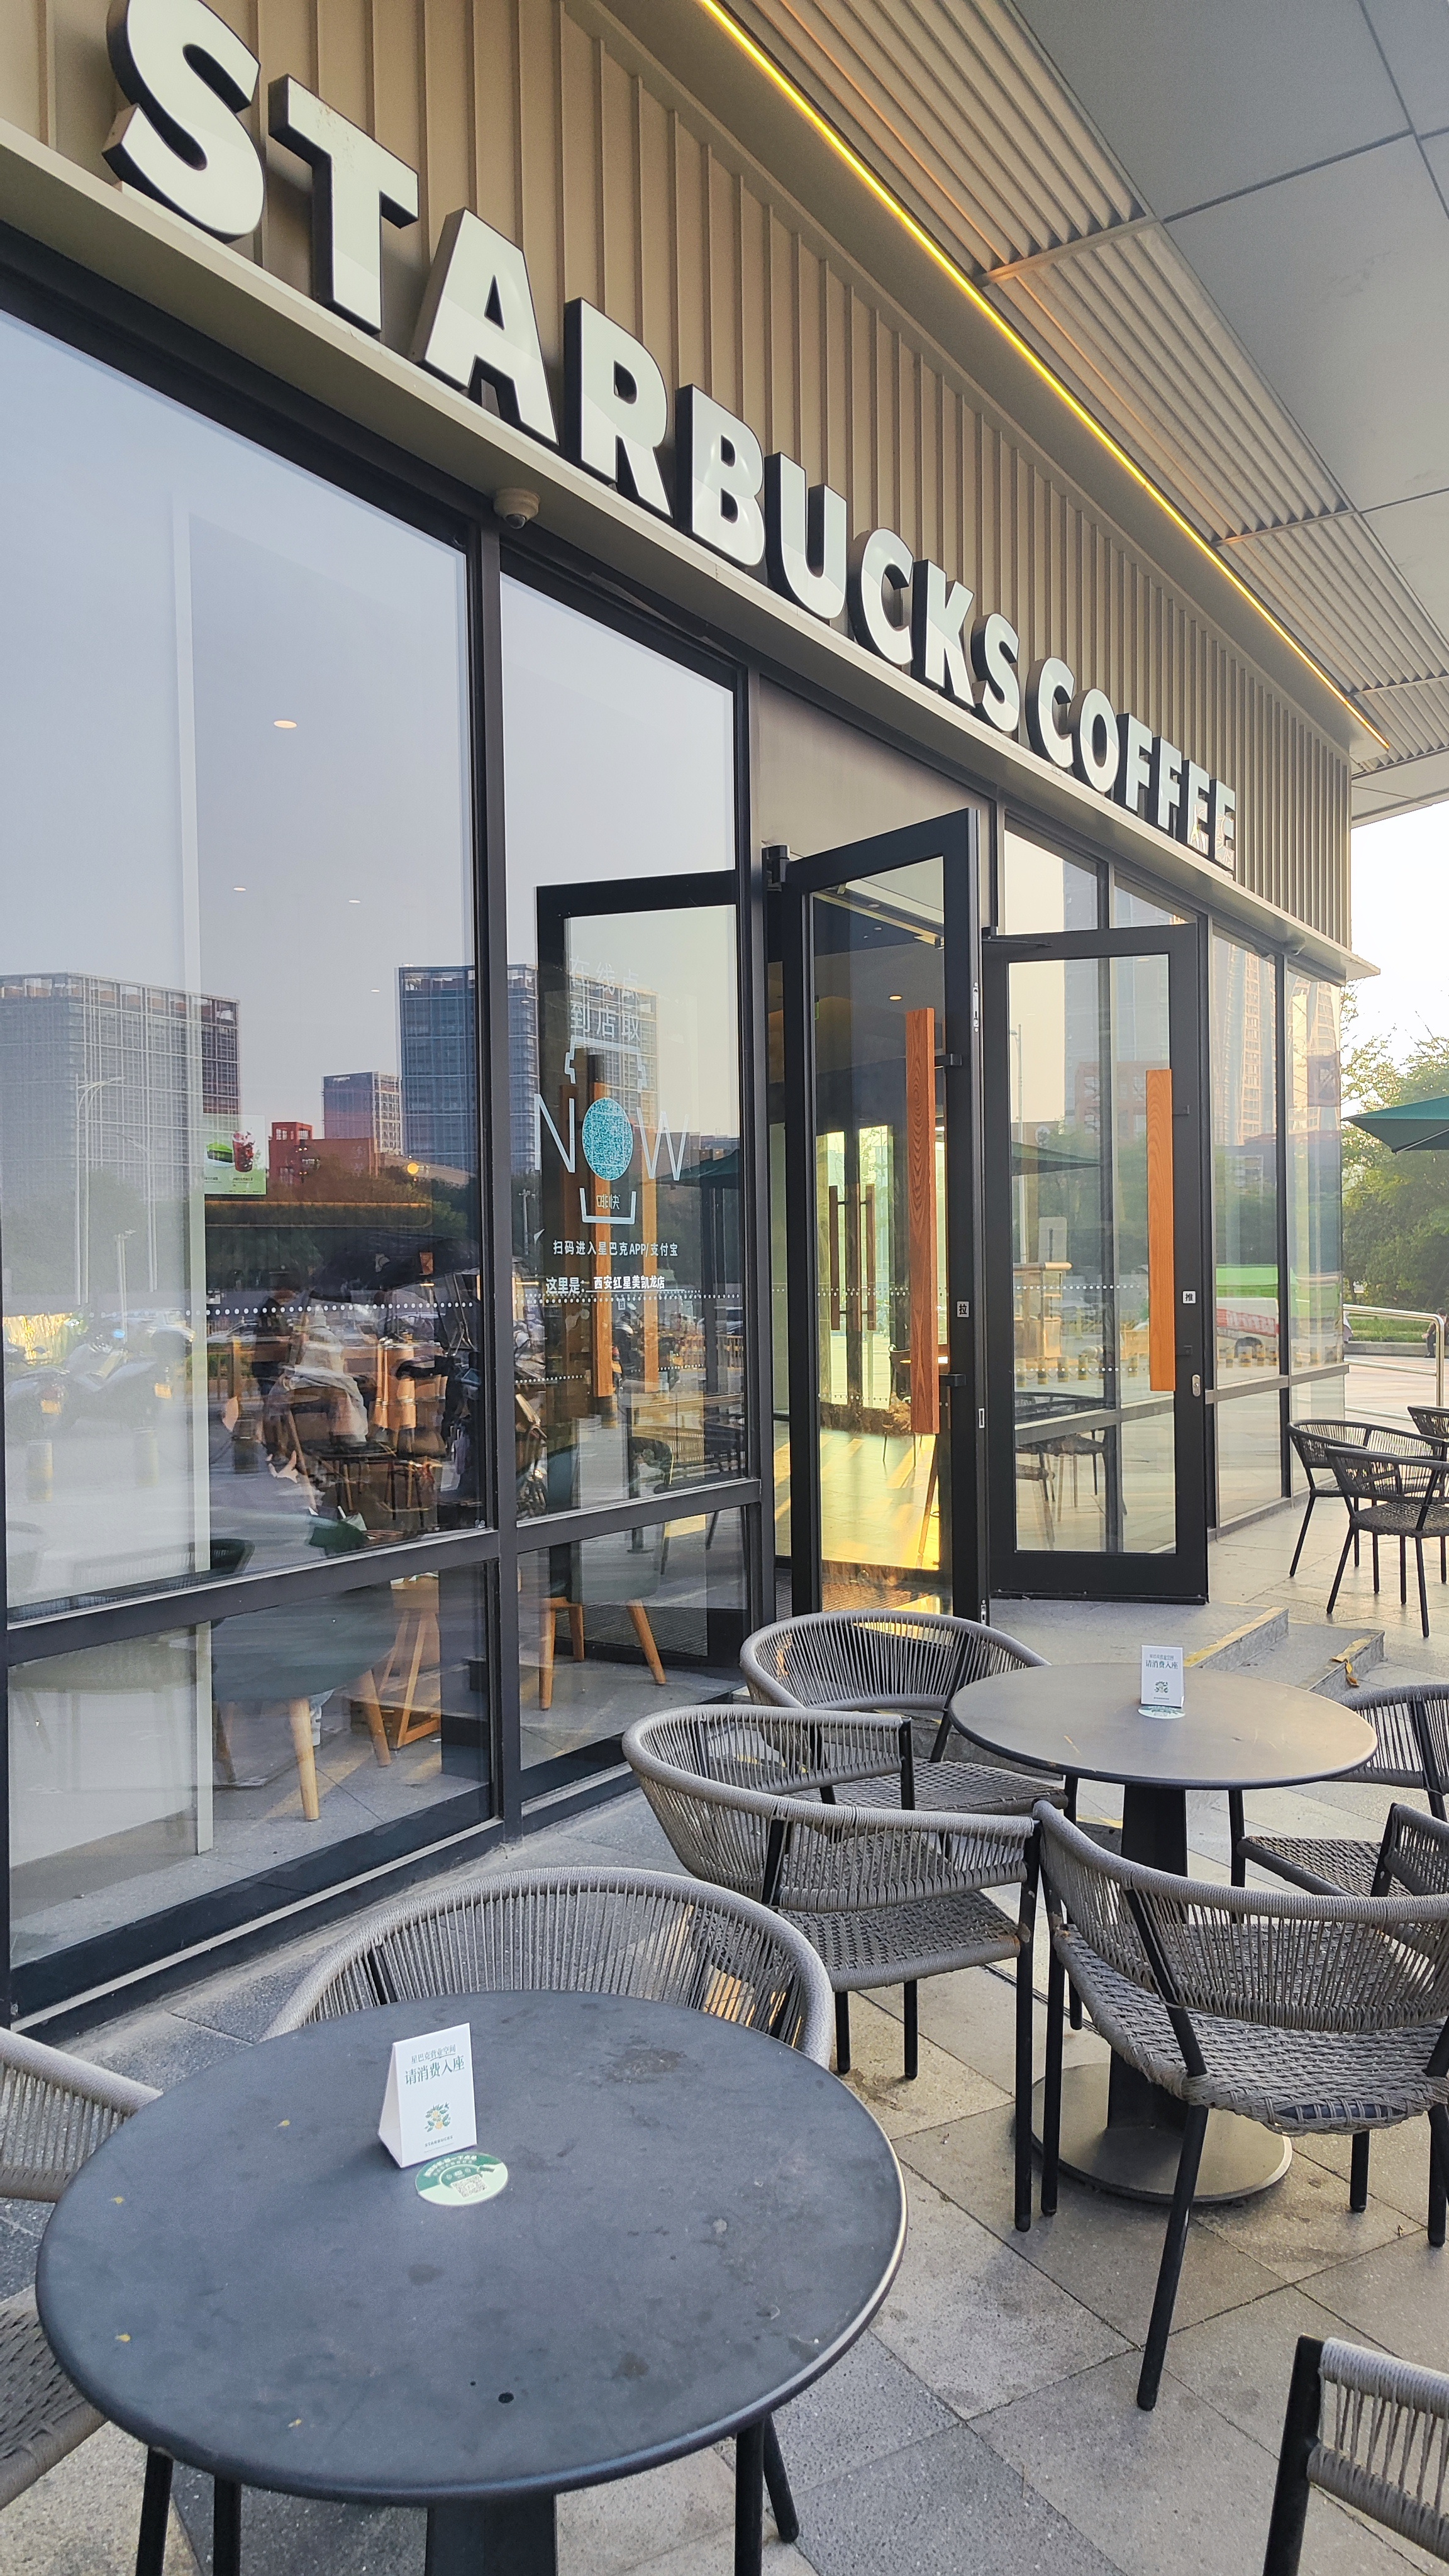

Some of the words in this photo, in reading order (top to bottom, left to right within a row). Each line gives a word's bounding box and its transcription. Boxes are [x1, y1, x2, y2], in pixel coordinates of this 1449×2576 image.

[104, 0, 1020, 735] STARBUCKS
[1026, 656, 1236, 872] COFFEE
[569, 955, 640, 1001] 在线点
[570, 1001, 640, 1041] 到店取
[594, 1275, 665, 1289] 西安红星美凯龙店
[1185, 1293, 1194, 1302] 推
[958, 1303, 967, 1315] 拉
[1146, 1660, 1178, 1669] 请消费入座
[411, 2044, 456, 2064] 星巴克营业空间
[405, 2055, 465, 2085] 请消费入座
[425, 2135, 453, 2147] STARBUCKS
